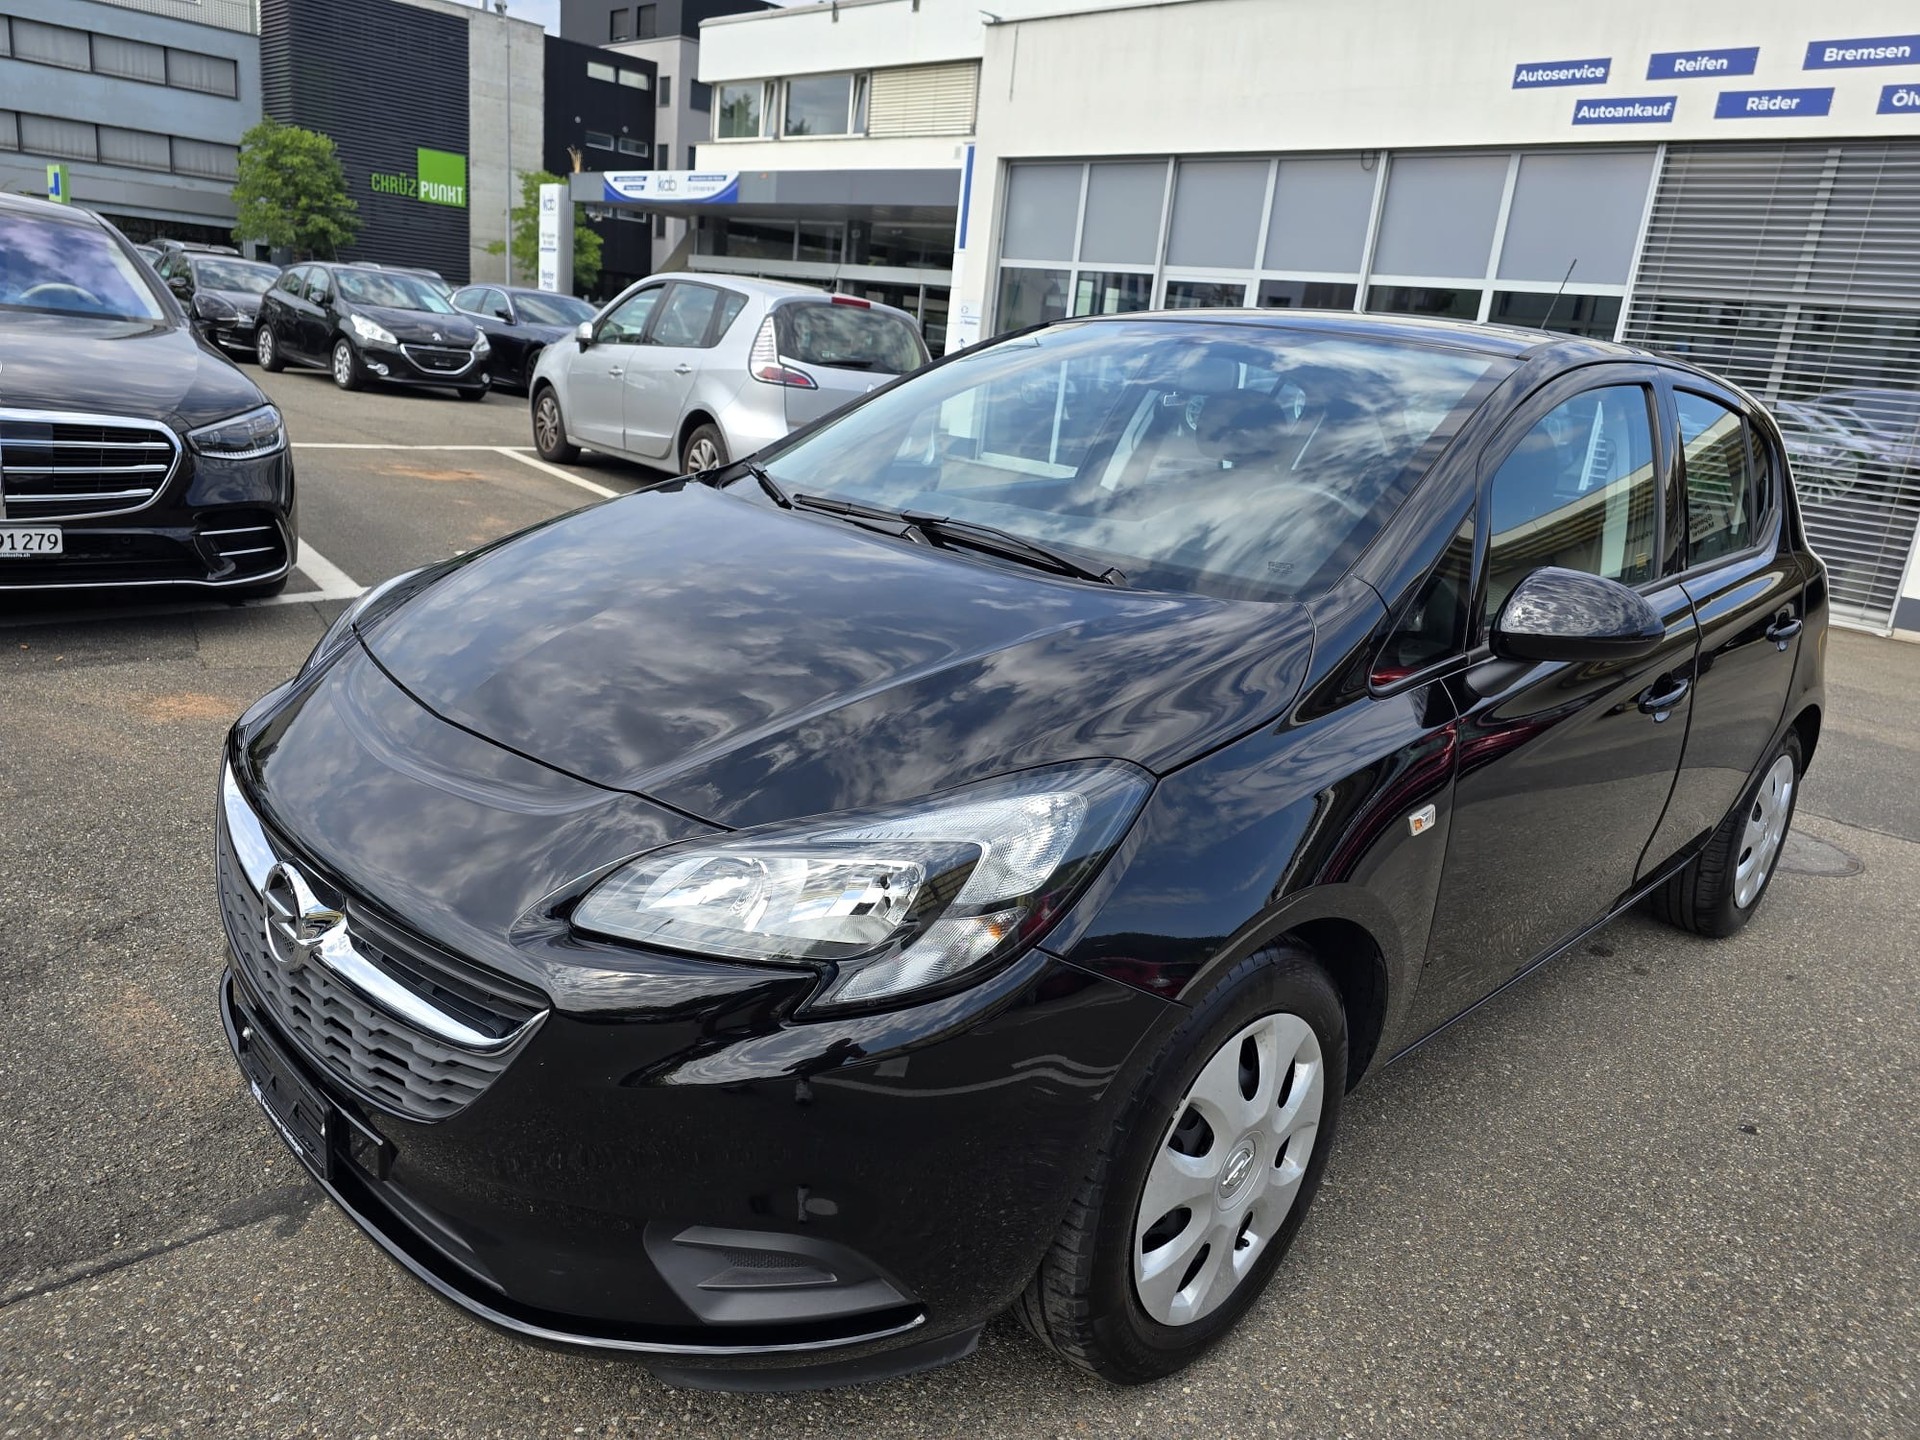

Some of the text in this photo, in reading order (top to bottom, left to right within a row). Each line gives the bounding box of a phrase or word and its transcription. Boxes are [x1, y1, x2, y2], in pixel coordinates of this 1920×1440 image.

[1823, 45, 1911, 62] Bremsen
[1674, 56, 1728, 72] Reifen
[1516, 65, 1605, 82] Autoservice
[1577, 102, 1672, 119] Autoankauf
[1746, 96, 1800, 110] Räder
[371, 172, 464, 204] CHRÜZ PUNKT
